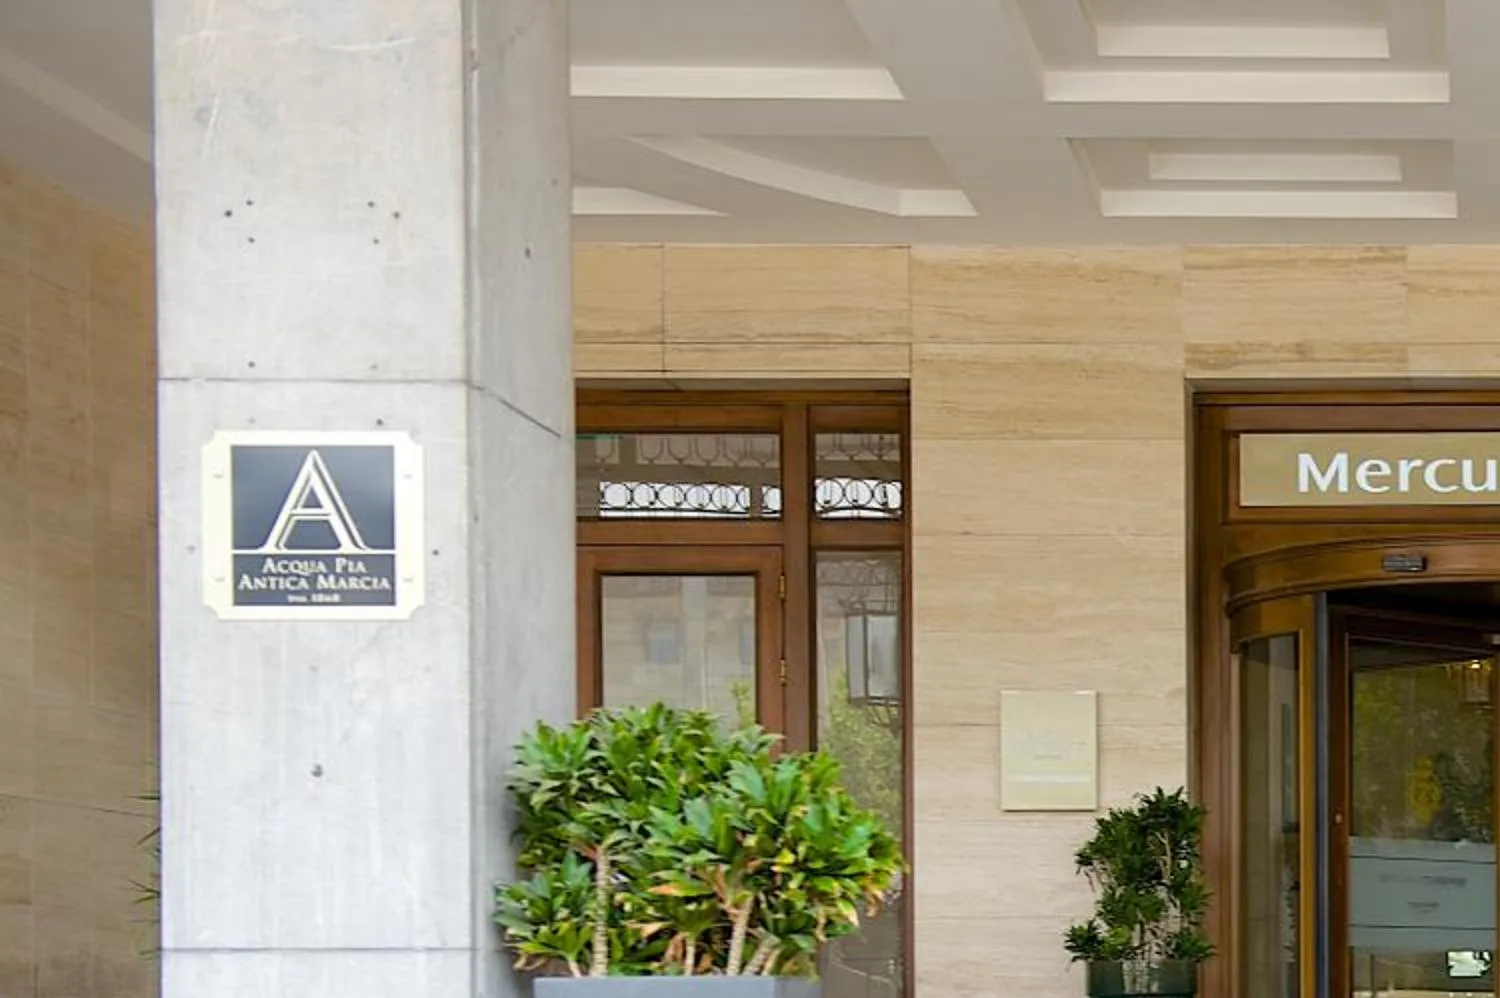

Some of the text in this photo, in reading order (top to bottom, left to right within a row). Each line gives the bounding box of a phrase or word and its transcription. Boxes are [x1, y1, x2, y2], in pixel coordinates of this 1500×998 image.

[257, 449, 371, 551] A
[262, 557, 367, 576] ACQUA PIA
[238, 574, 391, 590] ANTICA MARCIA
